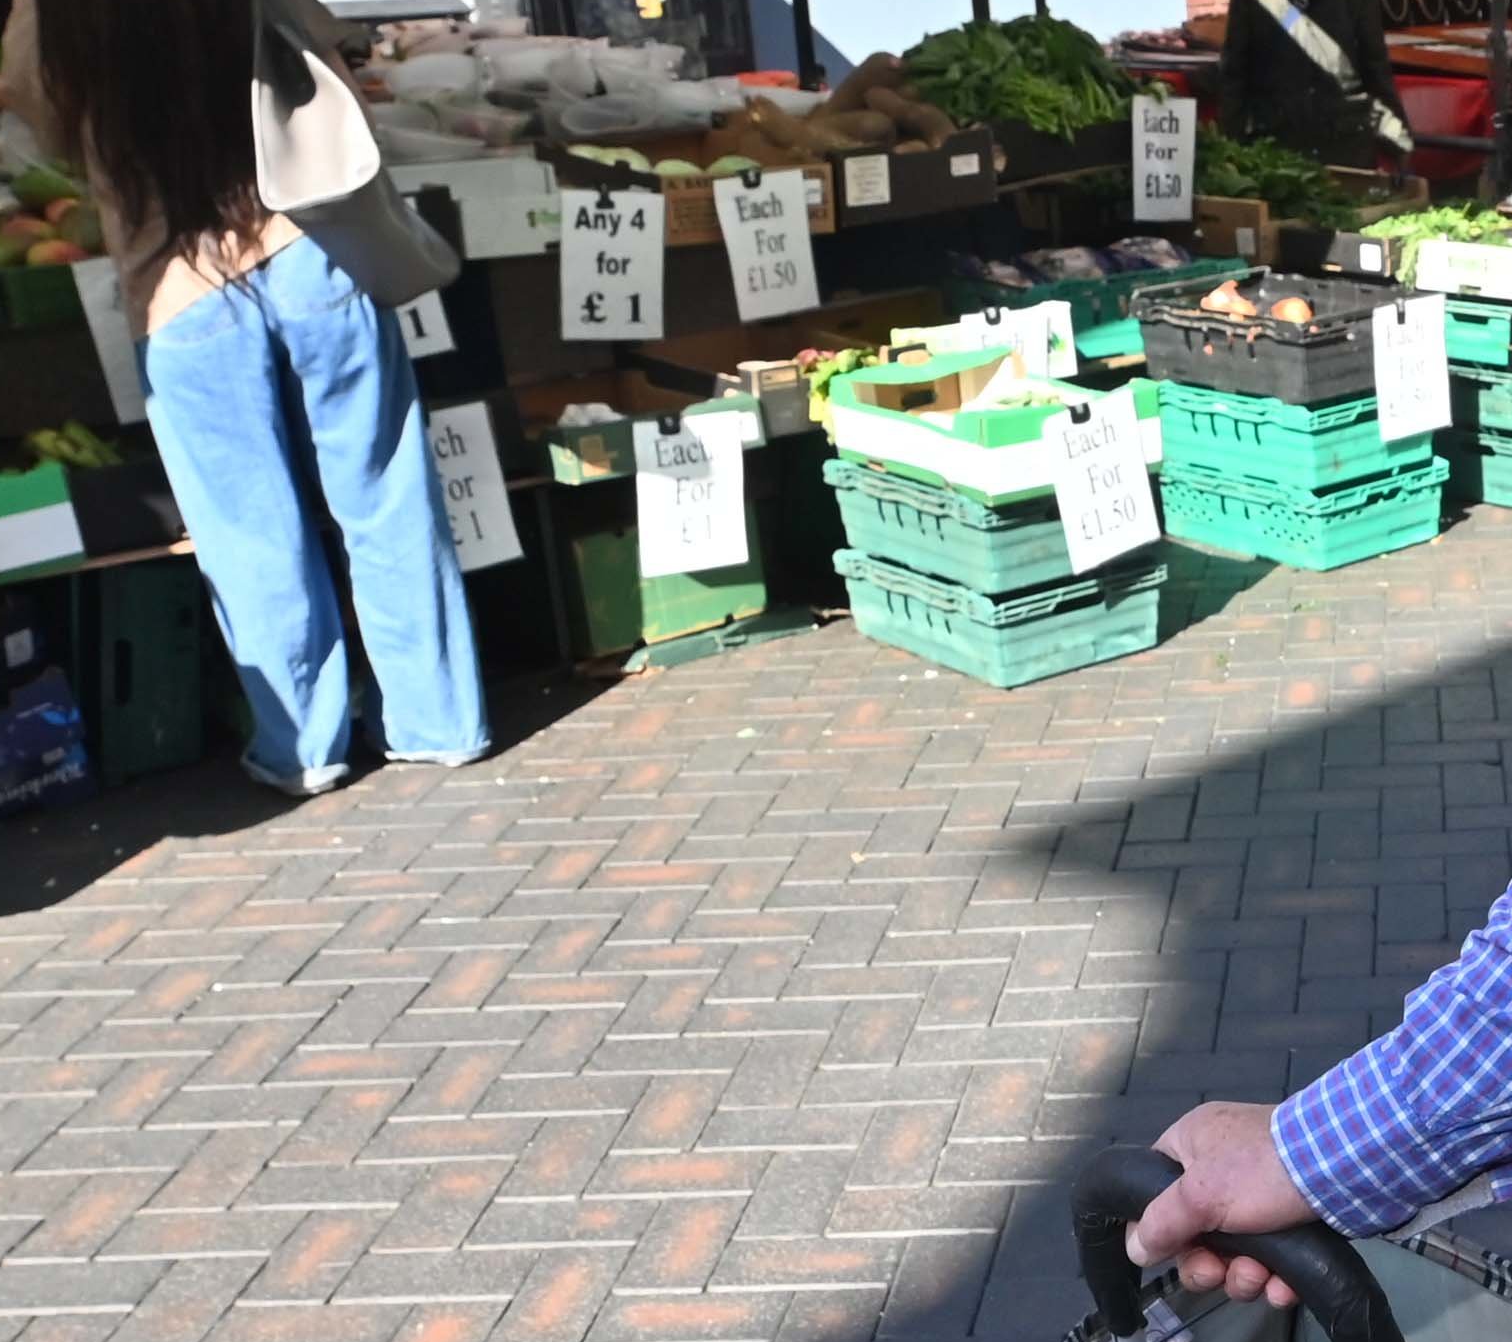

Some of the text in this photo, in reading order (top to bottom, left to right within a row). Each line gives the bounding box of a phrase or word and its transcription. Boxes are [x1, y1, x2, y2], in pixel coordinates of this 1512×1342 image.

[1143, 108, 1180, 135] Each
[1145, 141, 1179, 161] For
[574, 205, 622, 237] Any
[629, 208, 646, 231] 4
[734, 191, 784, 224] Each
[754, 228, 788, 257] For
[596, 251, 632, 276] for
[746, 259, 797, 294] £1.50
[579, 291, 645, 325] £ 1
[1063, 417, 1117, 460] Each
[446, 473, 476, 502] or
[675, 475, 715, 506] For
[1087, 463, 1124, 495] For
[1080, 494, 1137, 540] £1.50
